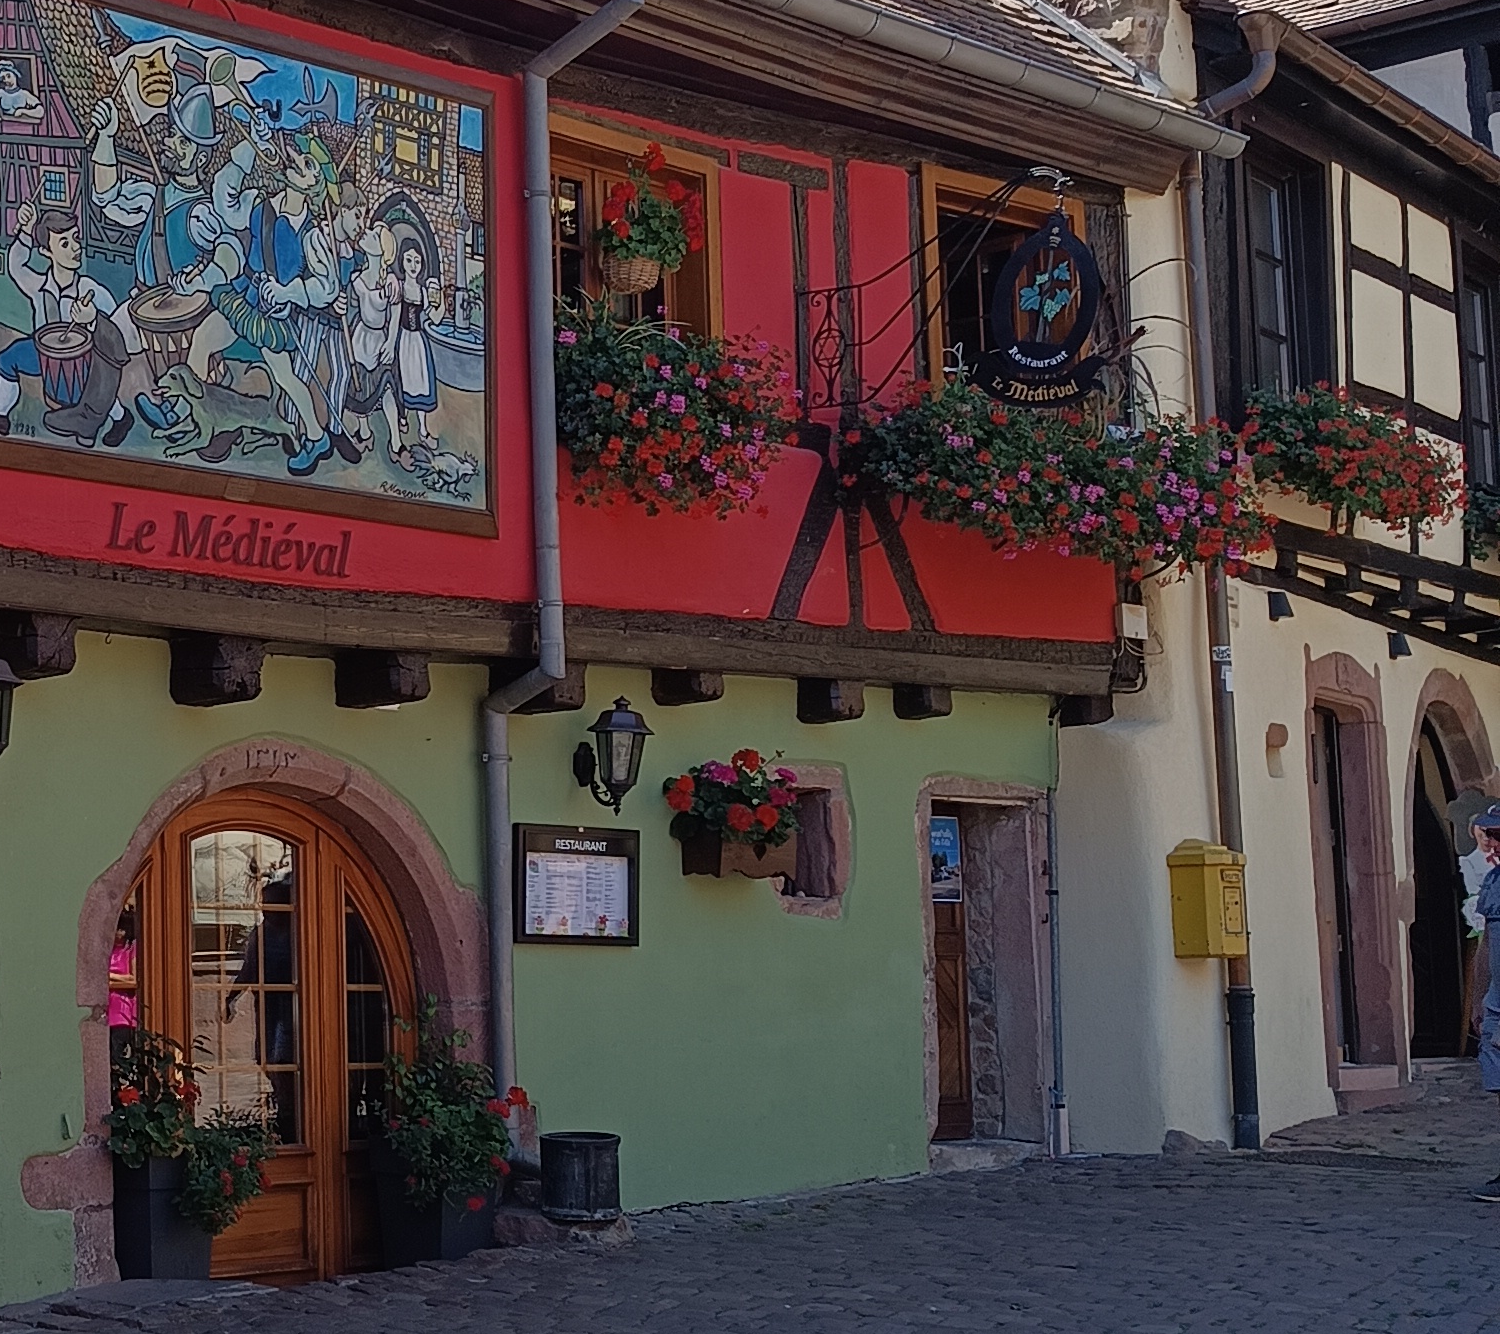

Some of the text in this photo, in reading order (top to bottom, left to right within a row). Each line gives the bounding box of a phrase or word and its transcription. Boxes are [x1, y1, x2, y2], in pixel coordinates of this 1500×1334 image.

[1007, 345, 1069, 368] Restaurant
[1004, 378, 1080, 402] Médiéval
[107, 502, 352, 579] Le Médiéval
[555, 839, 608, 852] RESTAURANT
